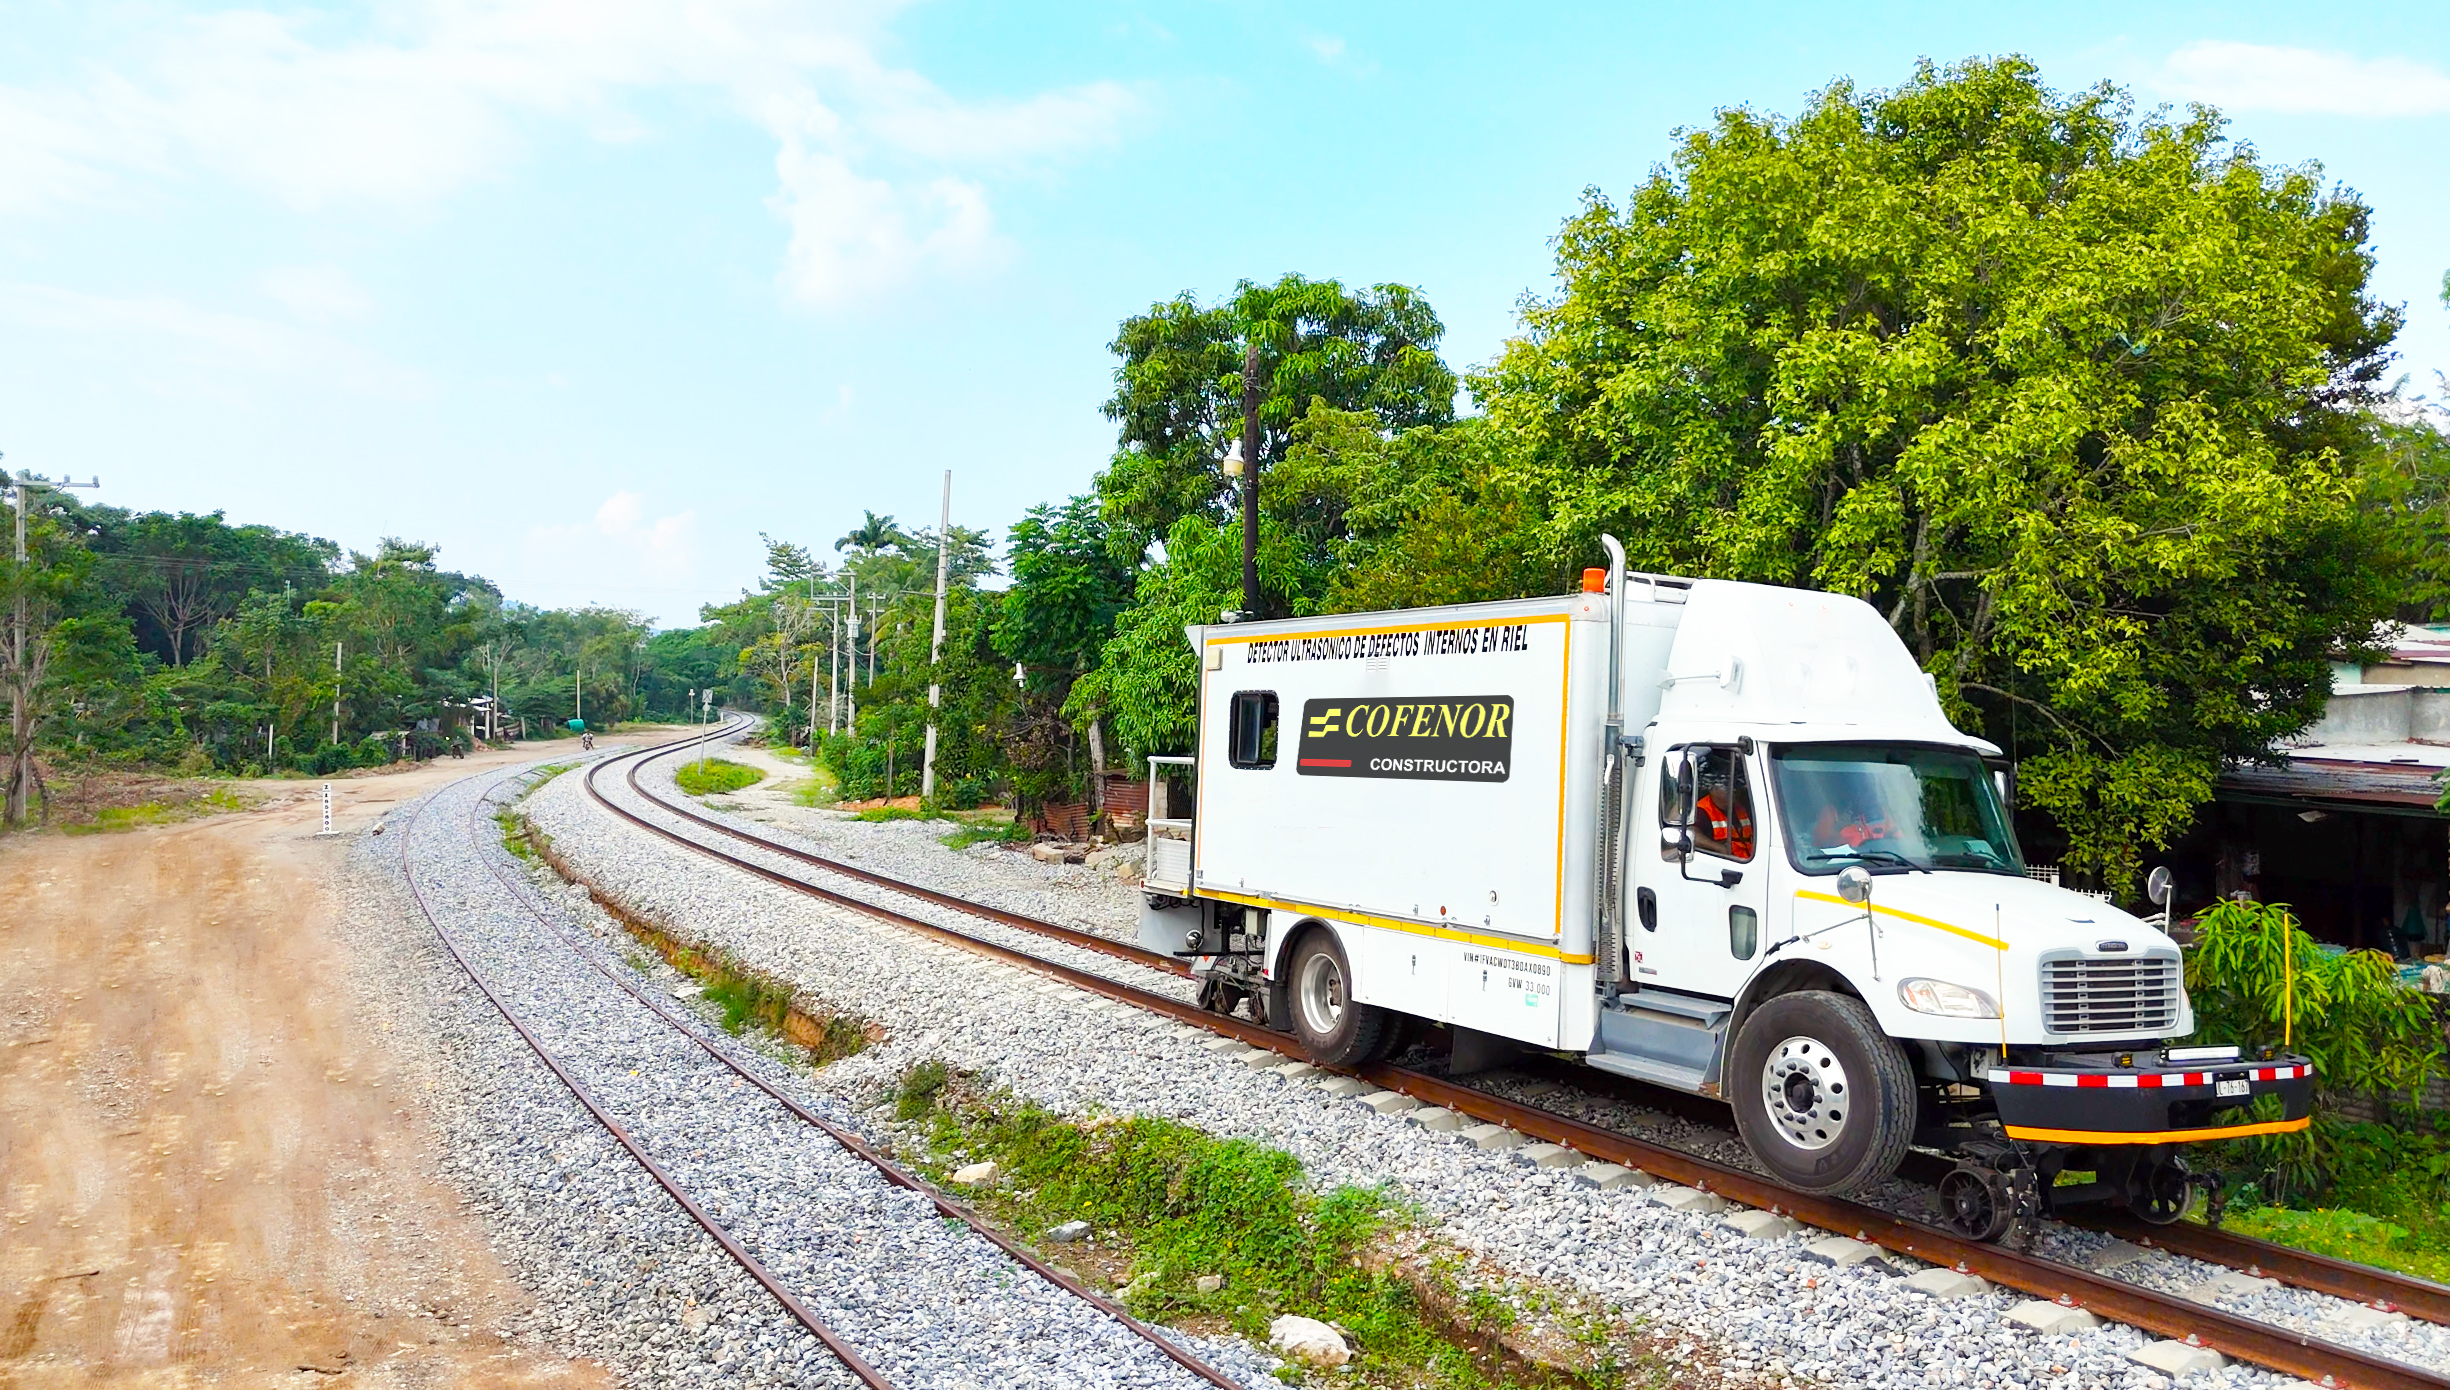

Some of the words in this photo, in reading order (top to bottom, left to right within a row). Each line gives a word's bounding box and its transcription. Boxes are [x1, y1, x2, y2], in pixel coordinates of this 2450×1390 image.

[1247, 639, 1290, 663] DETECTOR
[1290, 636, 1352, 662] ULTRASONICO
[1353, 635, 1367, 658] DE
[1367, 631, 1420, 658] DEFECTOS
[1423, 627, 1479, 655] INTERNOS
[1481, 626, 1499, 652] EN
[1501, 624, 1528, 652] RIEL
[1344, 703, 1510, 739] COFENOR
[1369, 757, 1506, 775] CONSTRUCTORA
[1508, 977, 1523, 989] GVW
